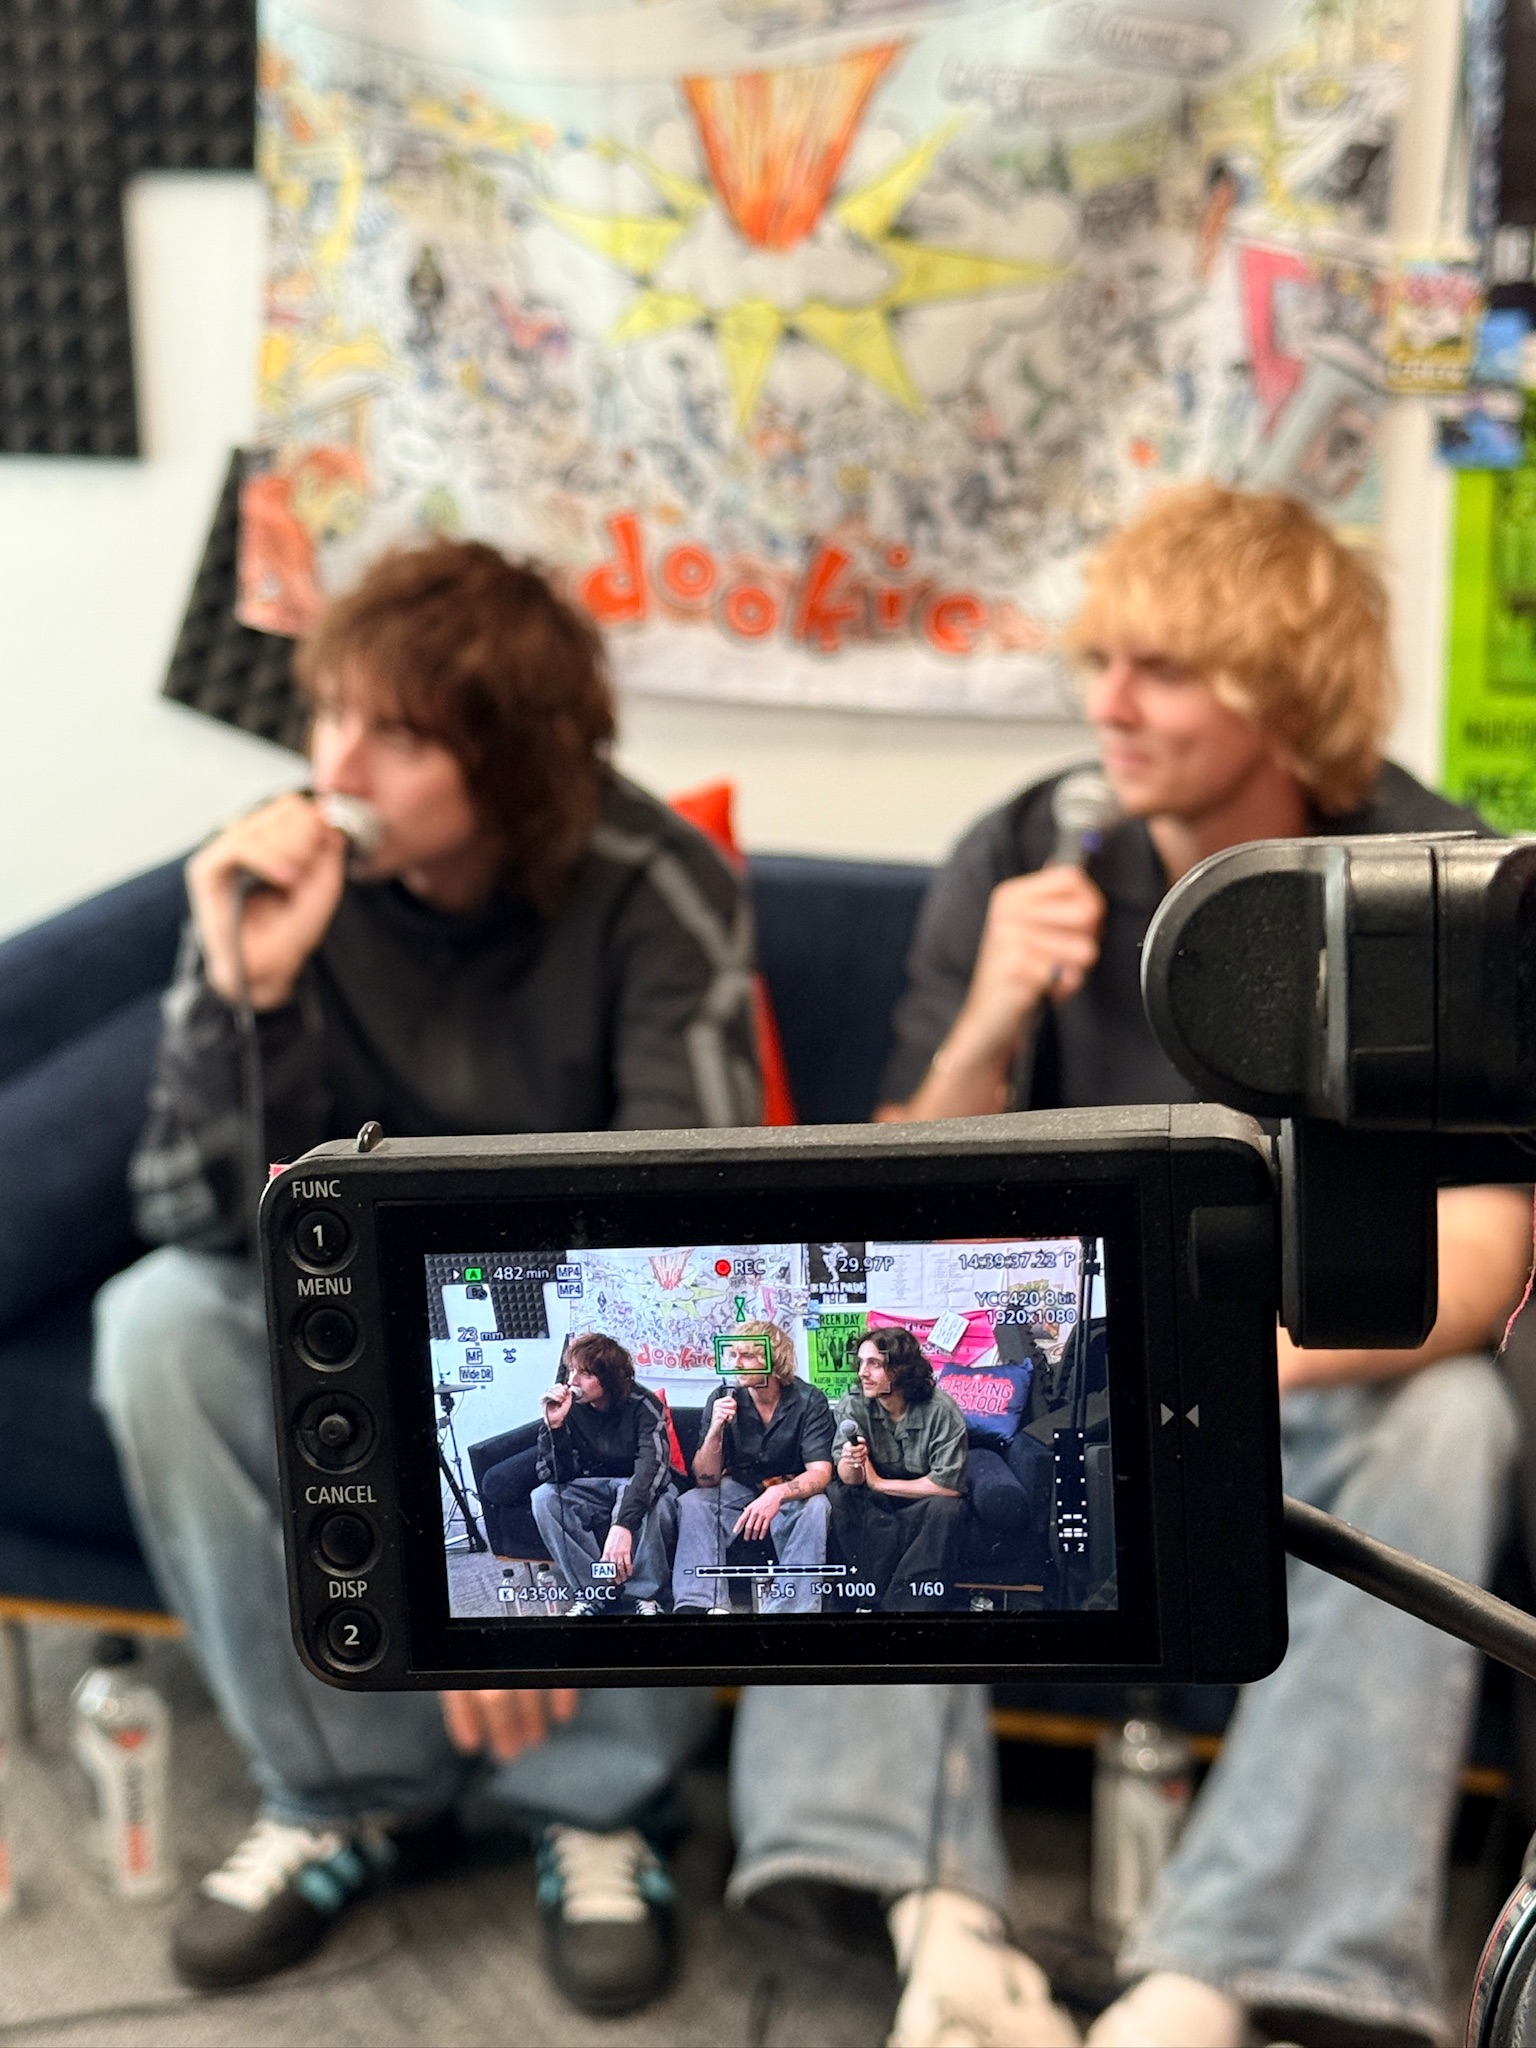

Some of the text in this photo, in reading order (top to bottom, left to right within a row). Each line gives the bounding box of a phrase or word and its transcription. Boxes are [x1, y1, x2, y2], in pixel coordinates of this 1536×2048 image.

[578, 512, 988, 653] dookie
[292, 1180, 341, 1199] FUNC
[312, 1224, 323, 1248] 1
[557, 1266, 581, 1277] MP4
[733, 1259, 766, 1275] REC
[838, 1256, 895, 1273] 29.97P
[493, 1266, 550, 1281] 482 min
[297, 1276, 352, 1296] MENU
[559, 1284, 581, 1295] MP4
[975, 1290, 1076, 1307] YCC420 8 bit
[820, 1314, 860, 1325] REEN DAY
[986, 1309, 1077, 1325] 1920x1080
[457, 1327, 504, 1342] 23 mm
[467, 1350, 482, 1360] MF
[461, 1369, 492, 1380] Wide DR
[305, 1485, 377, 1505] CANCEL
[1063, 1543, 1085, 1552] 1 2
[593, 1565, 615, 1576] FAN
[329, 1580, 368, 1599] DISP
[518, 1587, 568, 1601] 4350K
[574, 1586, 617, 1600] ±0CC
[811, 1582, 876, 1597] ISO 1000
[909, 1582, 945, 1596] 1/60
[343, 1624, 359, 1646] 2
